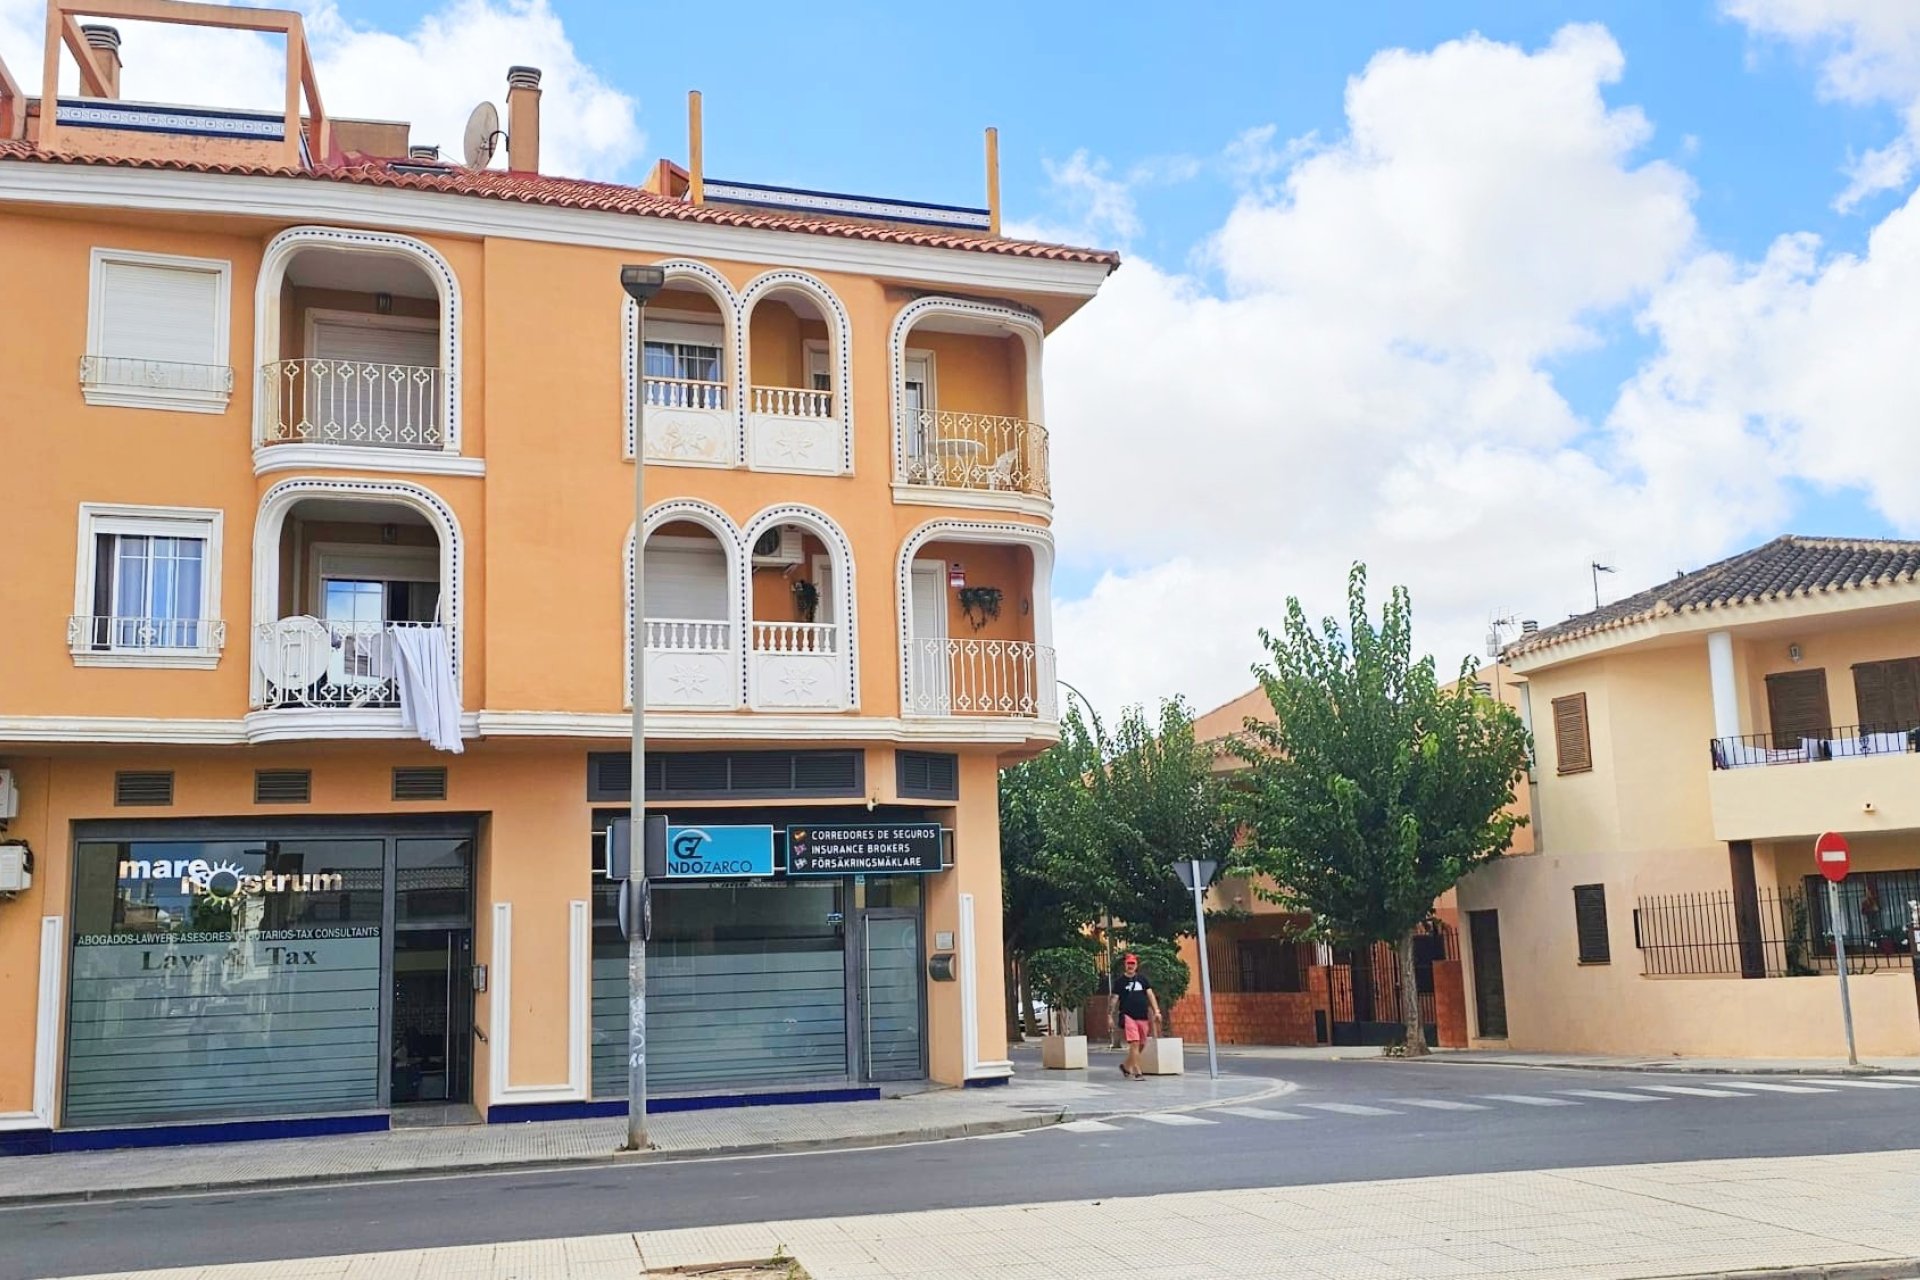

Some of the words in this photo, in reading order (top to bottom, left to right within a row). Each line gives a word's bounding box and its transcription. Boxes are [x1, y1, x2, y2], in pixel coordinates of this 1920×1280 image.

[811, 830, 874, 840] CORREDORES
[878, 830, 889, 839] DE
[893, 829, 935, 839] SEGUROS
[811, 844, 864, 855] INSURANCE
[867, 843, 911, 853] BROKERS
[668, 860, 753, 874] NDOZARCO
[811, 856, 922, 868] FÖRSÄKRINGSMÄKLARE
[119, 859, 209, 879] mare
[315, 927, 380, 938] CONSULTANTS
[265, 946, 318, 966] Tax
